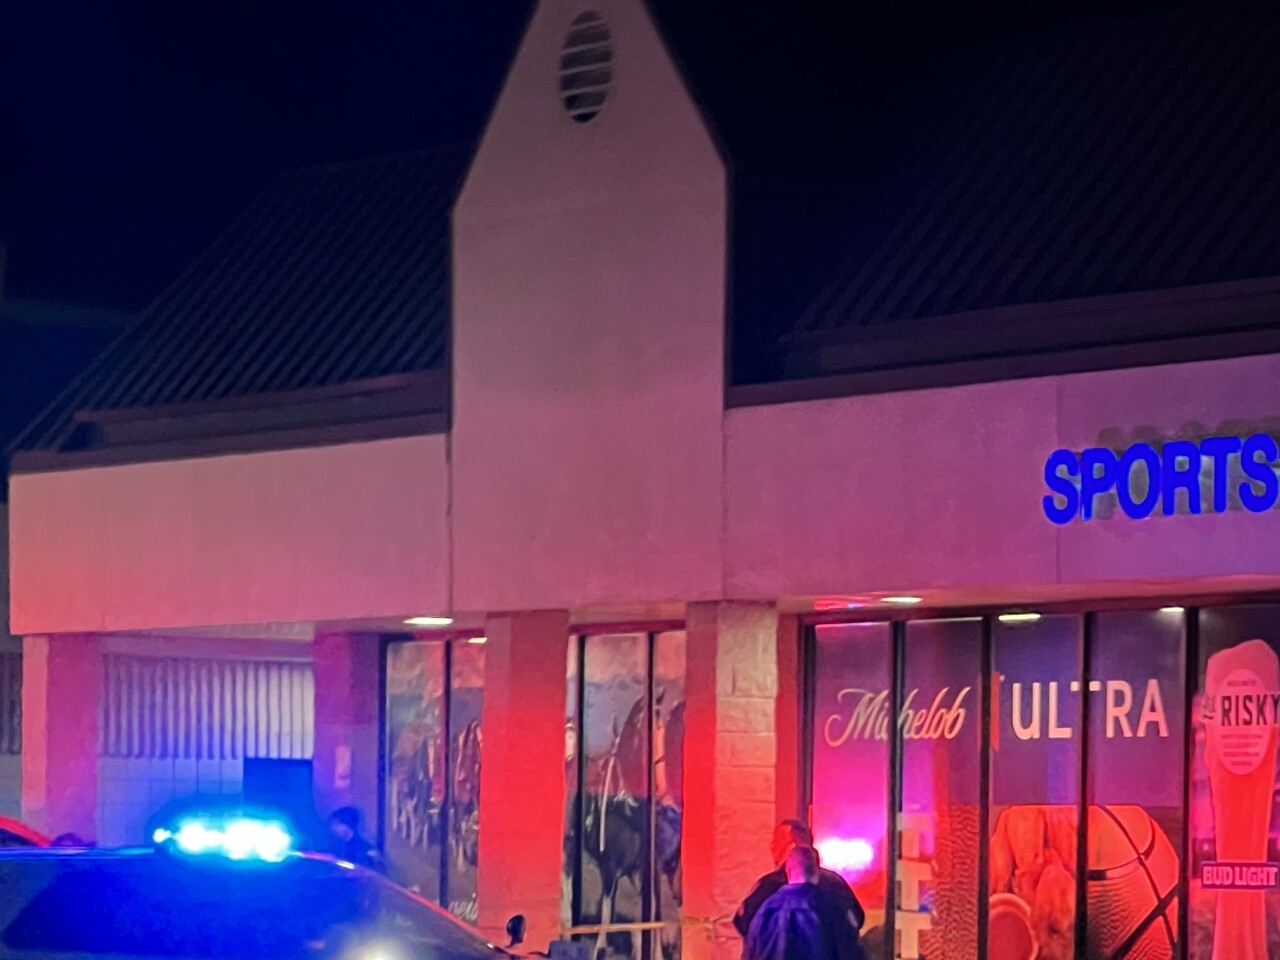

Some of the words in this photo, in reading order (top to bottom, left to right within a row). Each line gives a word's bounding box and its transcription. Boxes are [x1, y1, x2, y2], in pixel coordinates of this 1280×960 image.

[1043, 434, 1280, 524] SPORTS
[1203, 866, 1233, 886] BUD
[1234, 866, 1278, 886] LIGHT
